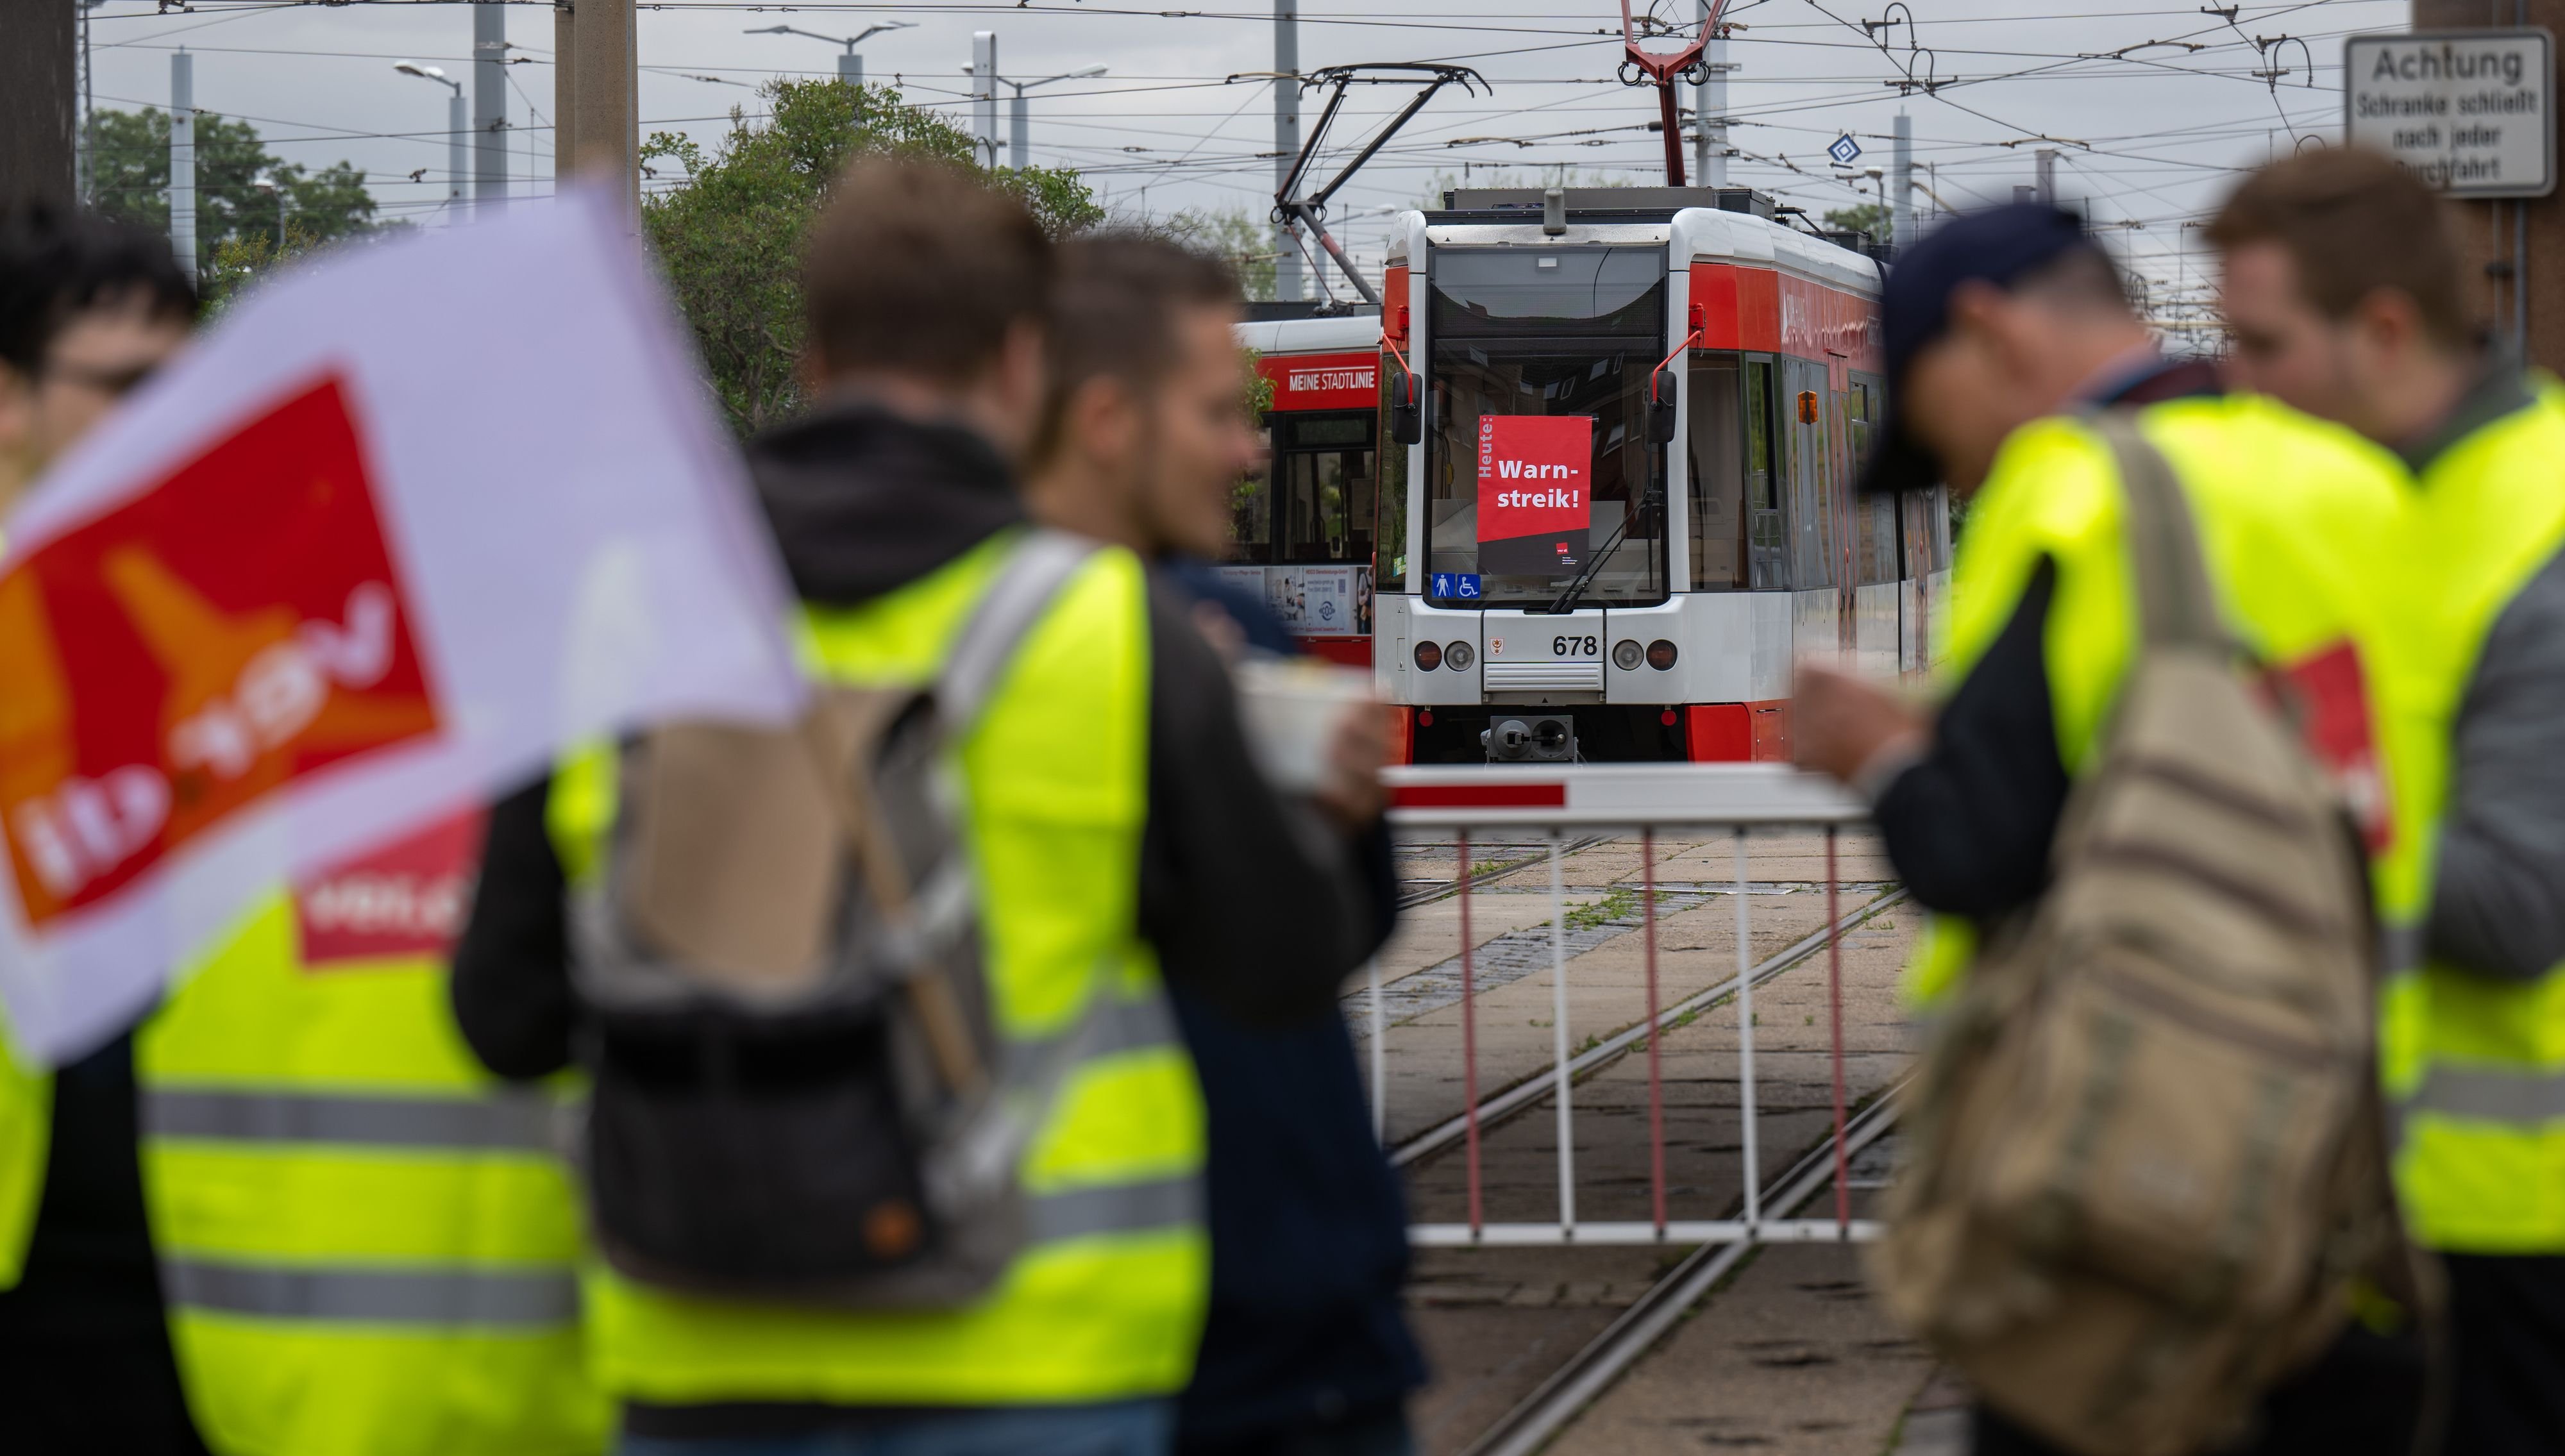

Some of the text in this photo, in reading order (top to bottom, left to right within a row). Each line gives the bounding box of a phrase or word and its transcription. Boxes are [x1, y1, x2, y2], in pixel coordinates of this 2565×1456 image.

[2373, 43, 2524, 86] Achtung
[2356, 88, 2538, 118] Schranke schließt
[2393, 124, 2500, 155] nach jeder
[1289, 371, 1375, 392] MEINE STADTLINIE
[1478, 418, 1493, 478] Heute:
[1498, 460, 1578, 479] Warn-
[1497, 488, 1579, 508] streik!
[1553, 635, 1597, 656] 678
[307, 875, 476, 935] ver.d
